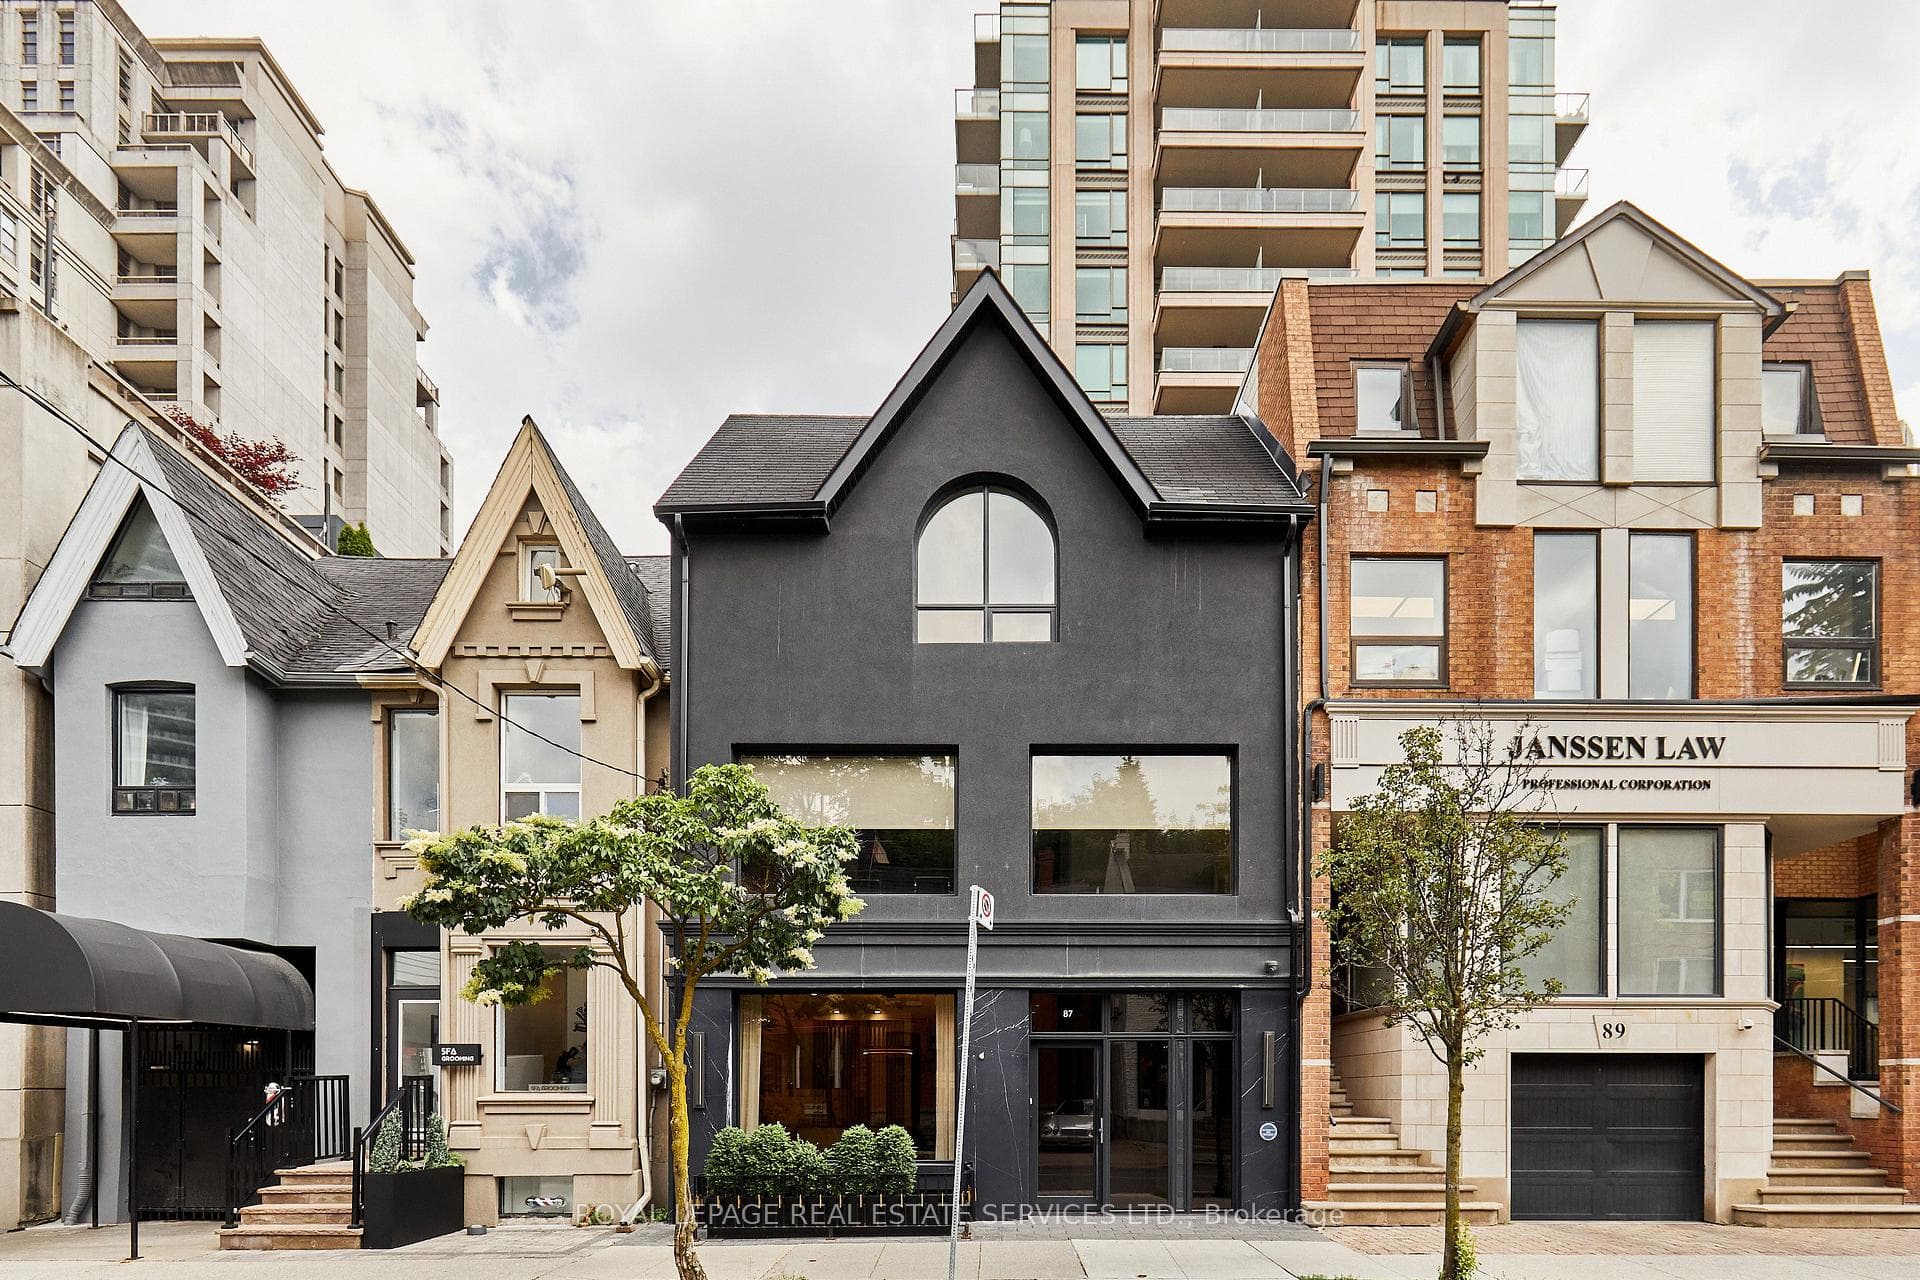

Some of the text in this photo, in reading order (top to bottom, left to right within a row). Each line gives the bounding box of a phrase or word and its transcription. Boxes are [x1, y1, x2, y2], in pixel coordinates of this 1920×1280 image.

[1509, 736, 1727, 760] JANSSEN LAW
[1522, 778, 1711, 791] PROFESSIONAL CORPORATION
[1062, 1009, 1074, 1018] 87
[1602, 1022, 1626, 1039] 89
